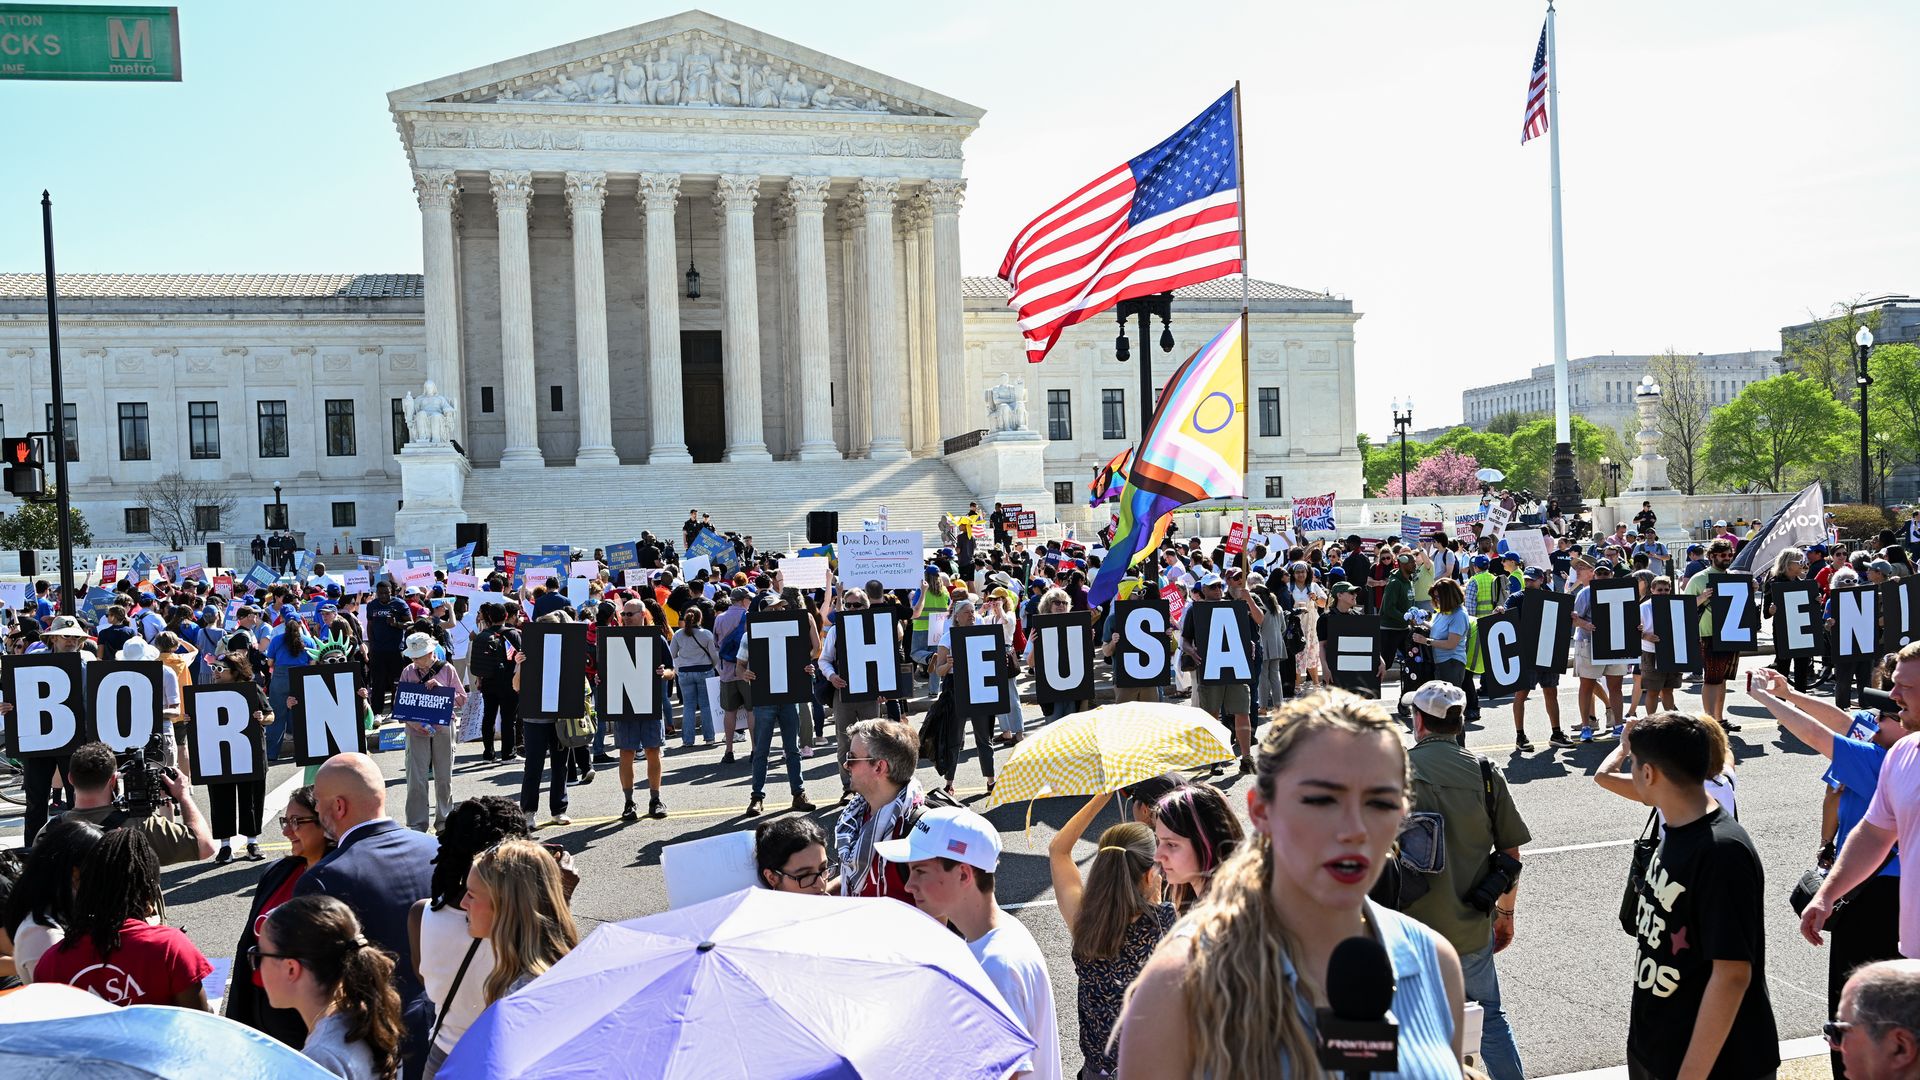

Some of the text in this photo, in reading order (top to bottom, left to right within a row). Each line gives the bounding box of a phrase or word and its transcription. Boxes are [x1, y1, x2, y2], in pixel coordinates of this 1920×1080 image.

[2, 33, 61, 56] CKS
[109, 19, 152, 59] M
[109, 63, 156, 74] metro
[398, 698, 446, 710] OUR RIGHT.
[400, 691, 452, 704] BIRTHRIGHT.
